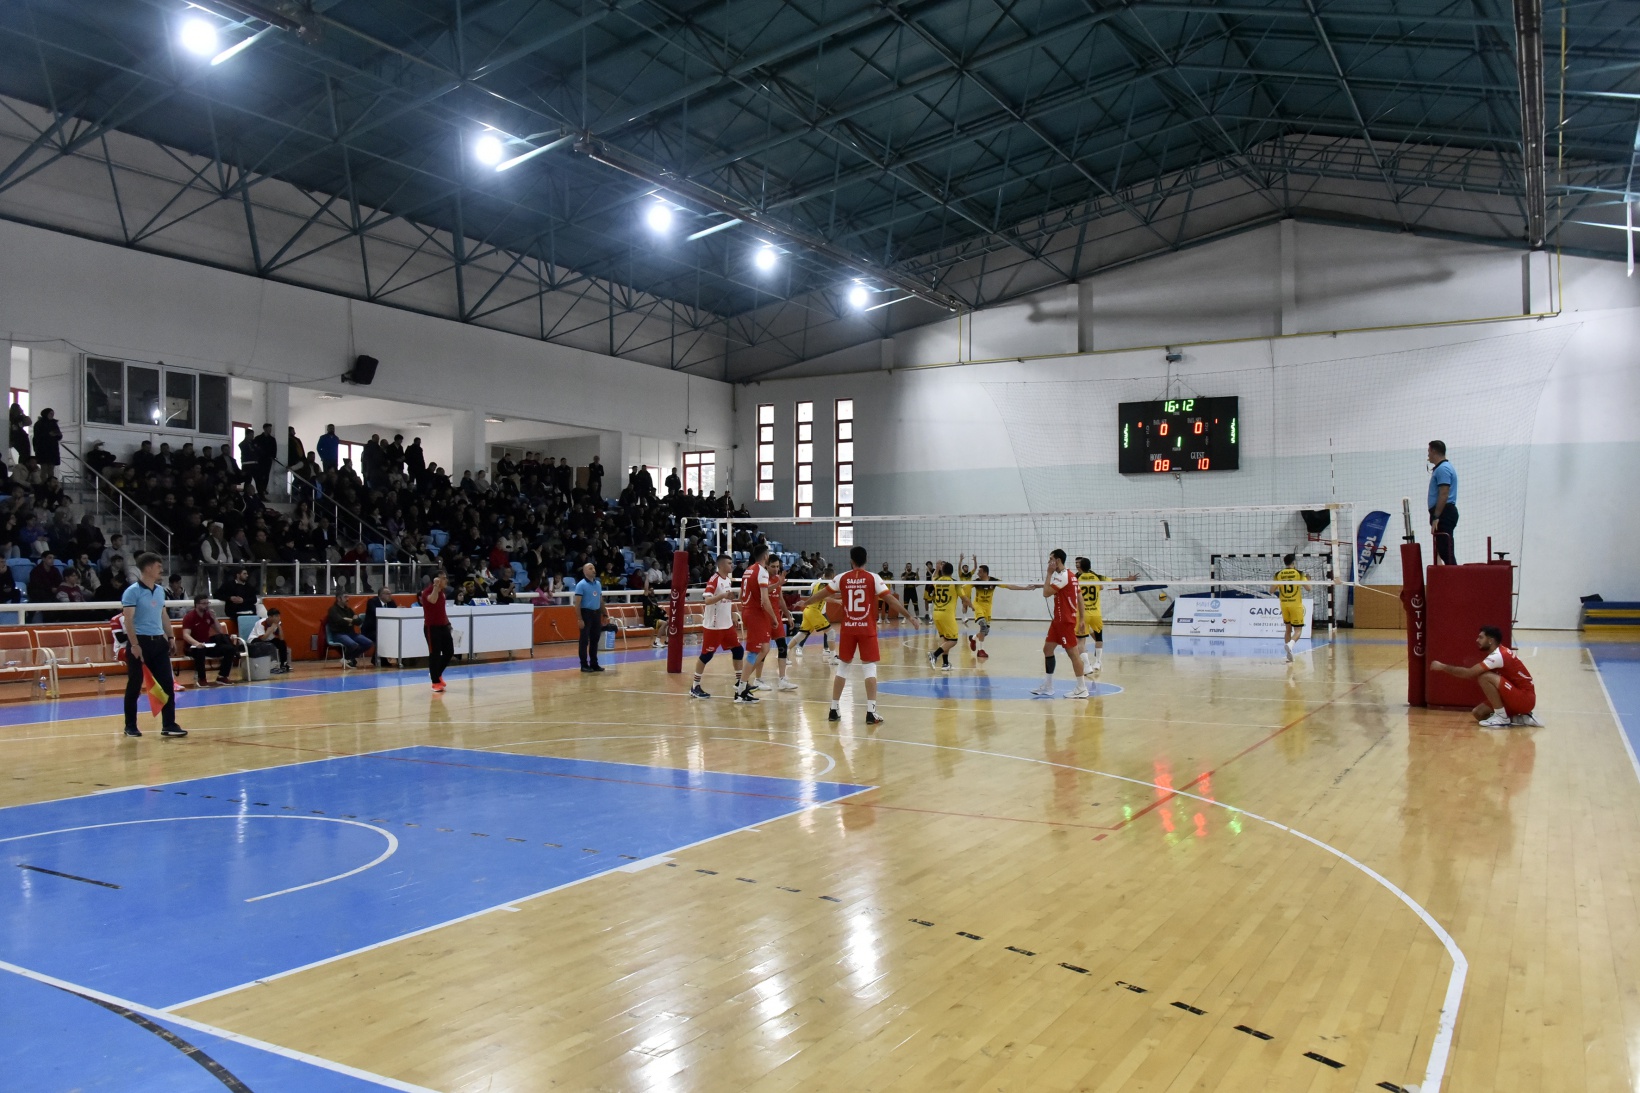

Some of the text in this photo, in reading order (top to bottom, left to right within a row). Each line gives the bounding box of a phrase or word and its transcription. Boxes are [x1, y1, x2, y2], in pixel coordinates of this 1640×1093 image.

[1164, 399, 1194, 413] 16:12
[1159, 423, 1168, 436] 0
[1194, 421, 1203, 434] 0
[1176, 436, 1182, 448] 1
[1190, 451, 1205, 459] GUEST
[1153, 459, 1170, 472] 08
[1197, 458, 1210, 470] 10
[1081, 586, 1096, 601] 29
[1283, 580, 1294, 594] 13
[848, 589, 866, 612] 12
[936, 589, 949, 603] 55
[1415, 610, 1423, 640] TVF
